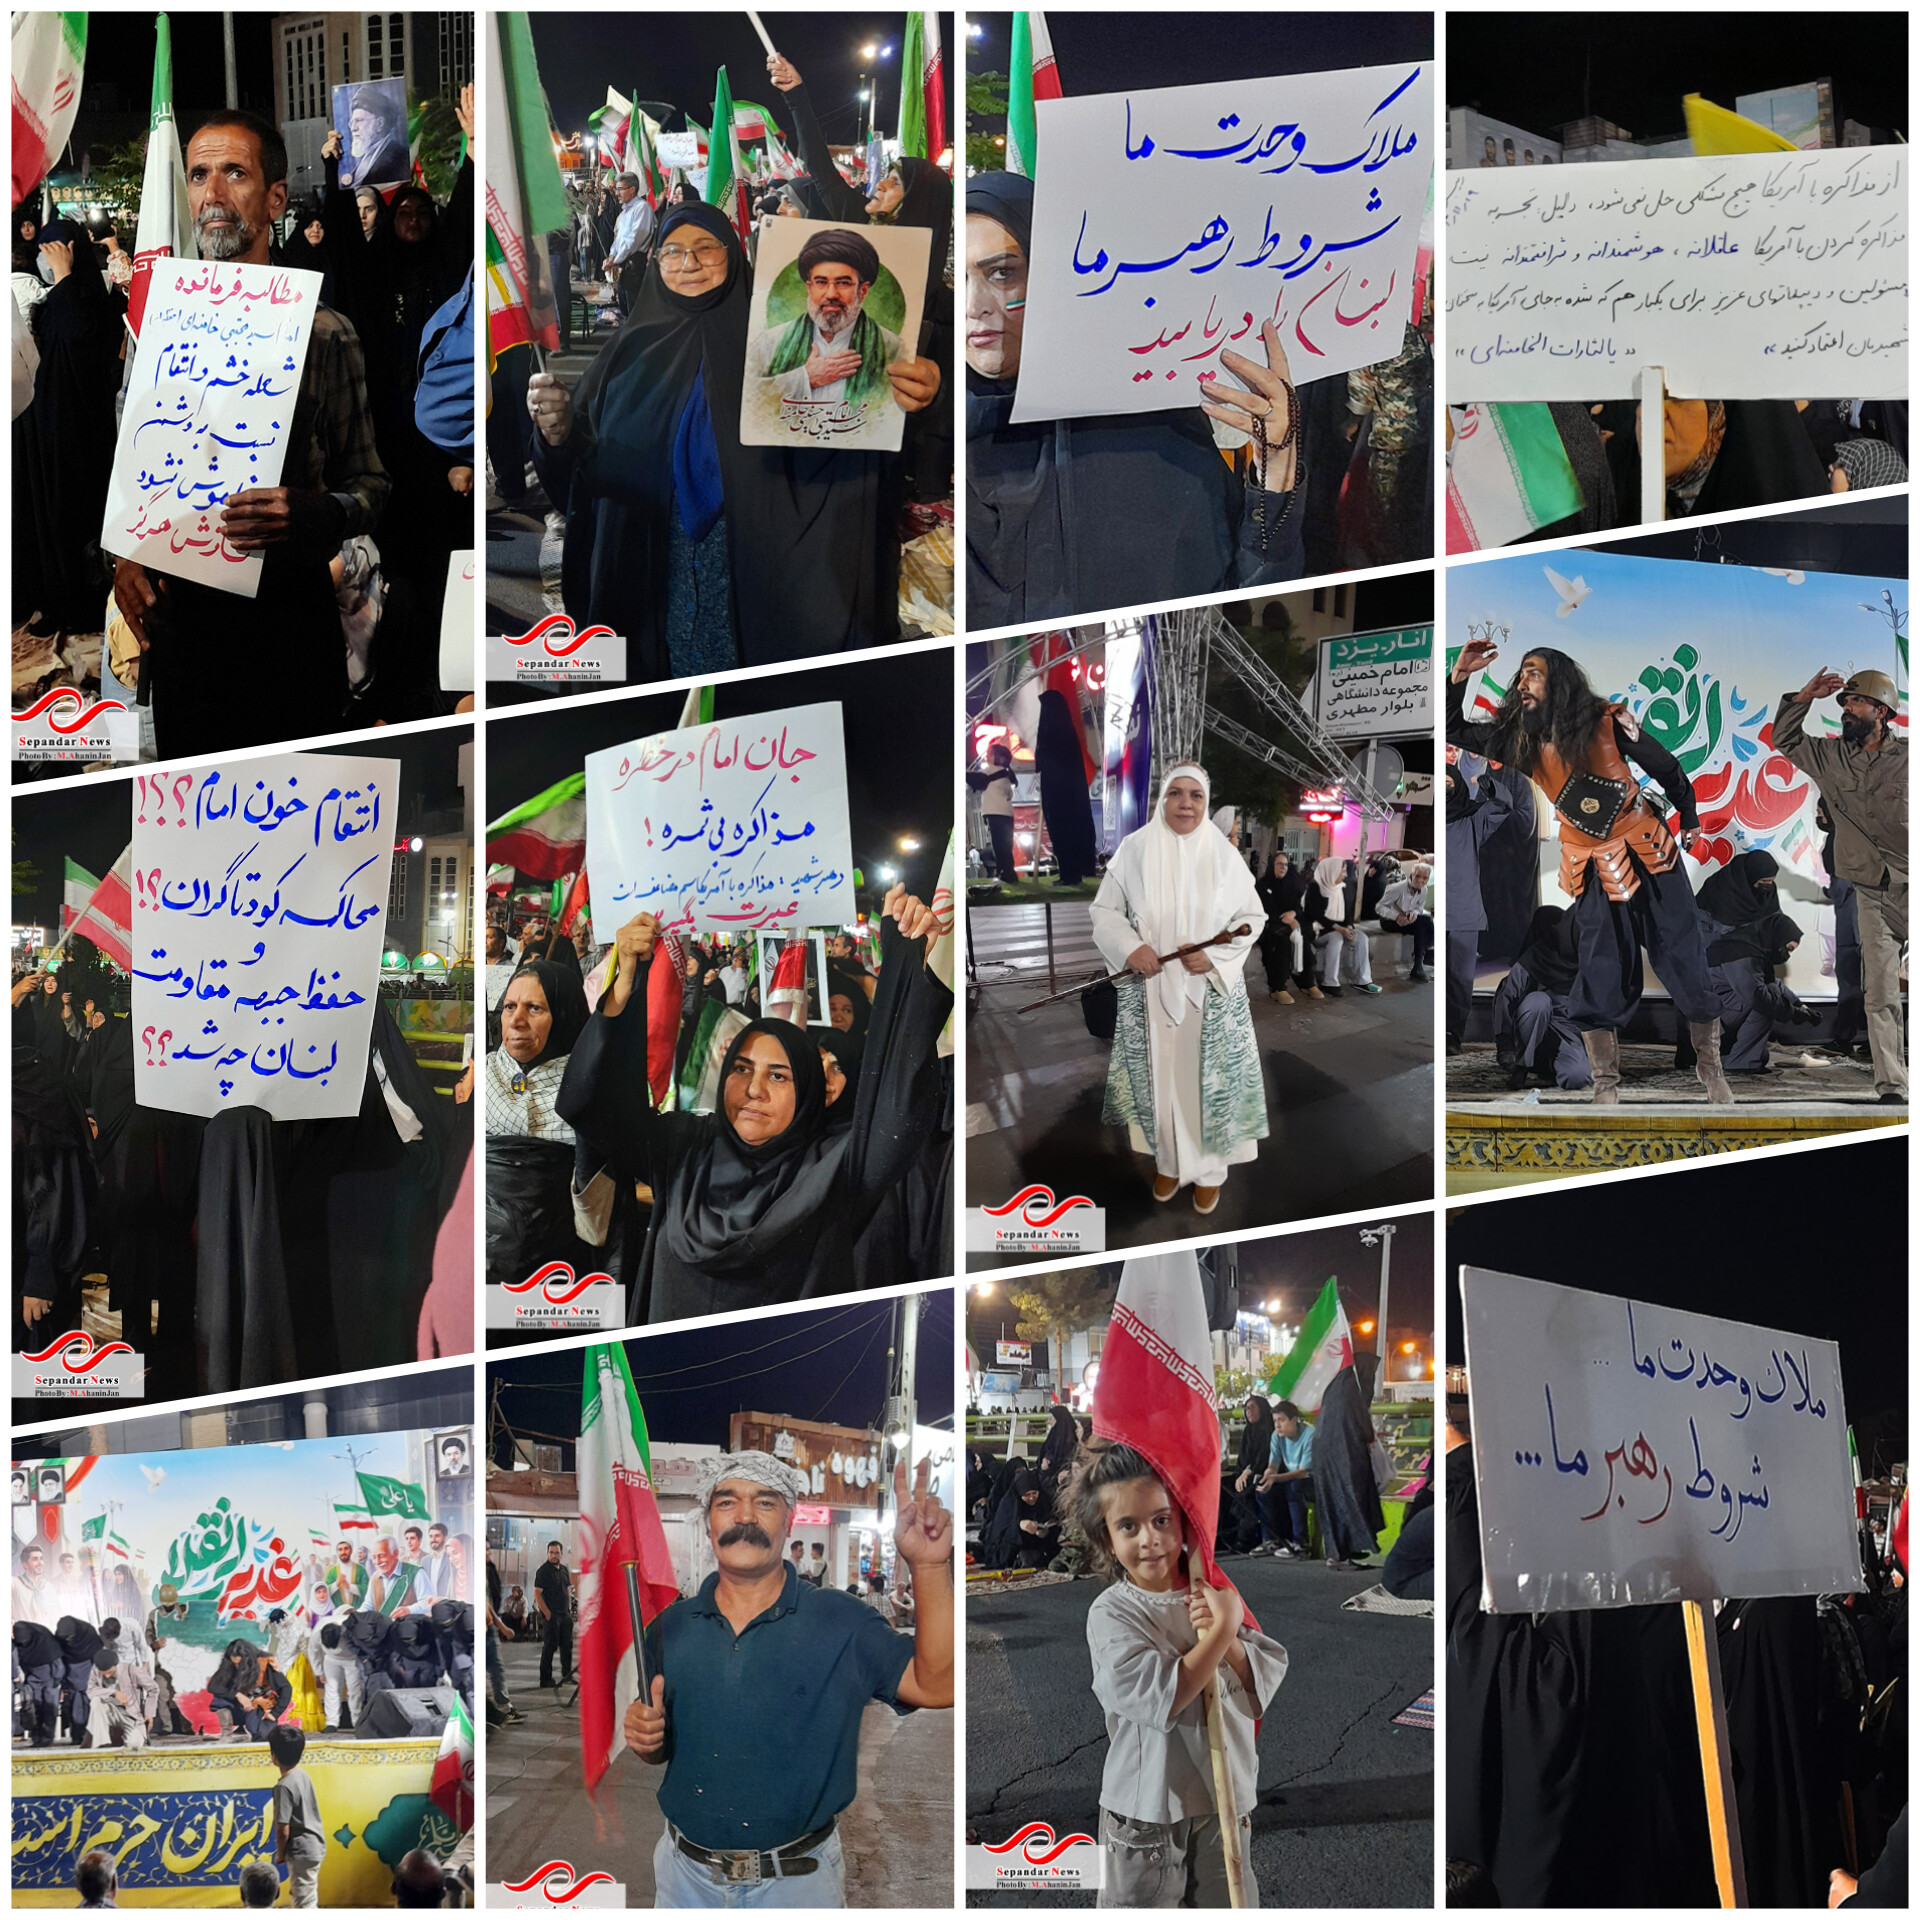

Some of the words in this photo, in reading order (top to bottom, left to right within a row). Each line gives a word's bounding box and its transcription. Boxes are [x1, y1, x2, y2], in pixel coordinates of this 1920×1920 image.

[1126, 98, 1156, 161] ما
[1299, 66, 1421, 174] ملاک
[1162, 112, 1307, 175] وحدت
[1675, 173, 1728, 215] مشکلی
[1761, 158, 1820, 208] آمریکا
[1809, 179, 1818, 203] با
[1821, 153, 1876, 205] مذاکره
[1876, 160, 1901, 196] از
[1487, 188, 1538, 225] تجربه
[1643, 189, 1675, 217] حل
[1072, 209, 1109, 275] ما
[1235, 186, 1402, 280] شروط
[1587, 230, 1665, 262] هوشمندانه
[1753, 224, 1806, 266] آمریکا
[1795, 237, 1805, 259] با
[1805, 219, 1871, 261] کردن
[1856, 212, 1906, 262] مذاکره
[1076, 213, 1236, 309] رهبر
[1449, 243, 1490, 270] نیست
[1571, 252, 1581, 263] و
[174, 263, 243, 306] فرمانده
[238, 272, 304, 313] مطالبه
[1487, 282, 1529, 314] آمریکا
[1565, 282, 1593, 307] شده
[1597, 279, 1625, 305] که
[1669, 287, 1706, 313] برای
[1711, 289, 1746, 316] عزیز
[1256, 285, 1289, 342] را
[1295, 260, 1396, 357] لبنان
[1611, 292, 1636, 323] هم
[1807, 330, 1845, 354] اعتماد
[153, 341, 201, 391] انتقام
[195, 354, 251, 417] خشم
[241, 355, 296, 399] شعله
[192, 423, 210, 450] به
[209, 420, 281, 463] نسبت
[135, 452, 180, 490] نشود
[125, 486, 172, 541] هرگز
[1332, 664, 1380, 688] خمینی
[1380, 660, 1415, 686] امام
[1382, 683, 1429, 699] مجموعه
[1325, 704, 1378, 721] مطهری
[1326, 686, 1381, 707] دانشگاهی
[1380, 699, 1415, 716] بلوار
[698, 726, 740, 792] امام
[743, 725, 818, 783] جان
[195, 770, 238, 830] امام
[243, 776, 309, 832] خون
[314, 782, 381, 847] انتقام
[719, 772, 816, 858] مذاکره
[661, 798, 714, 852] ثمره
[737, 850, 775, 898] مذاکره
[705, 900, 799, 929] عبرت
[131, 948, 231, 1001] مقاومت
[237, 941, 266, 966] و
[297, 967, 367, 1011] حفظ
[249, 1037, 338, 1087] لبنان
[1626, 1299, 1657, 1379] ما
[1657, 1337, 1752, 1419] وحدت
[381, 1484, 405, 1509] علی
[1579, 1430, 1674, 1525] رهبر
[1685, 1415, 1770, 1543] شروط
[402, 1488, 415, 1512] یا
[160, 1797, 276, 1874] ایران
